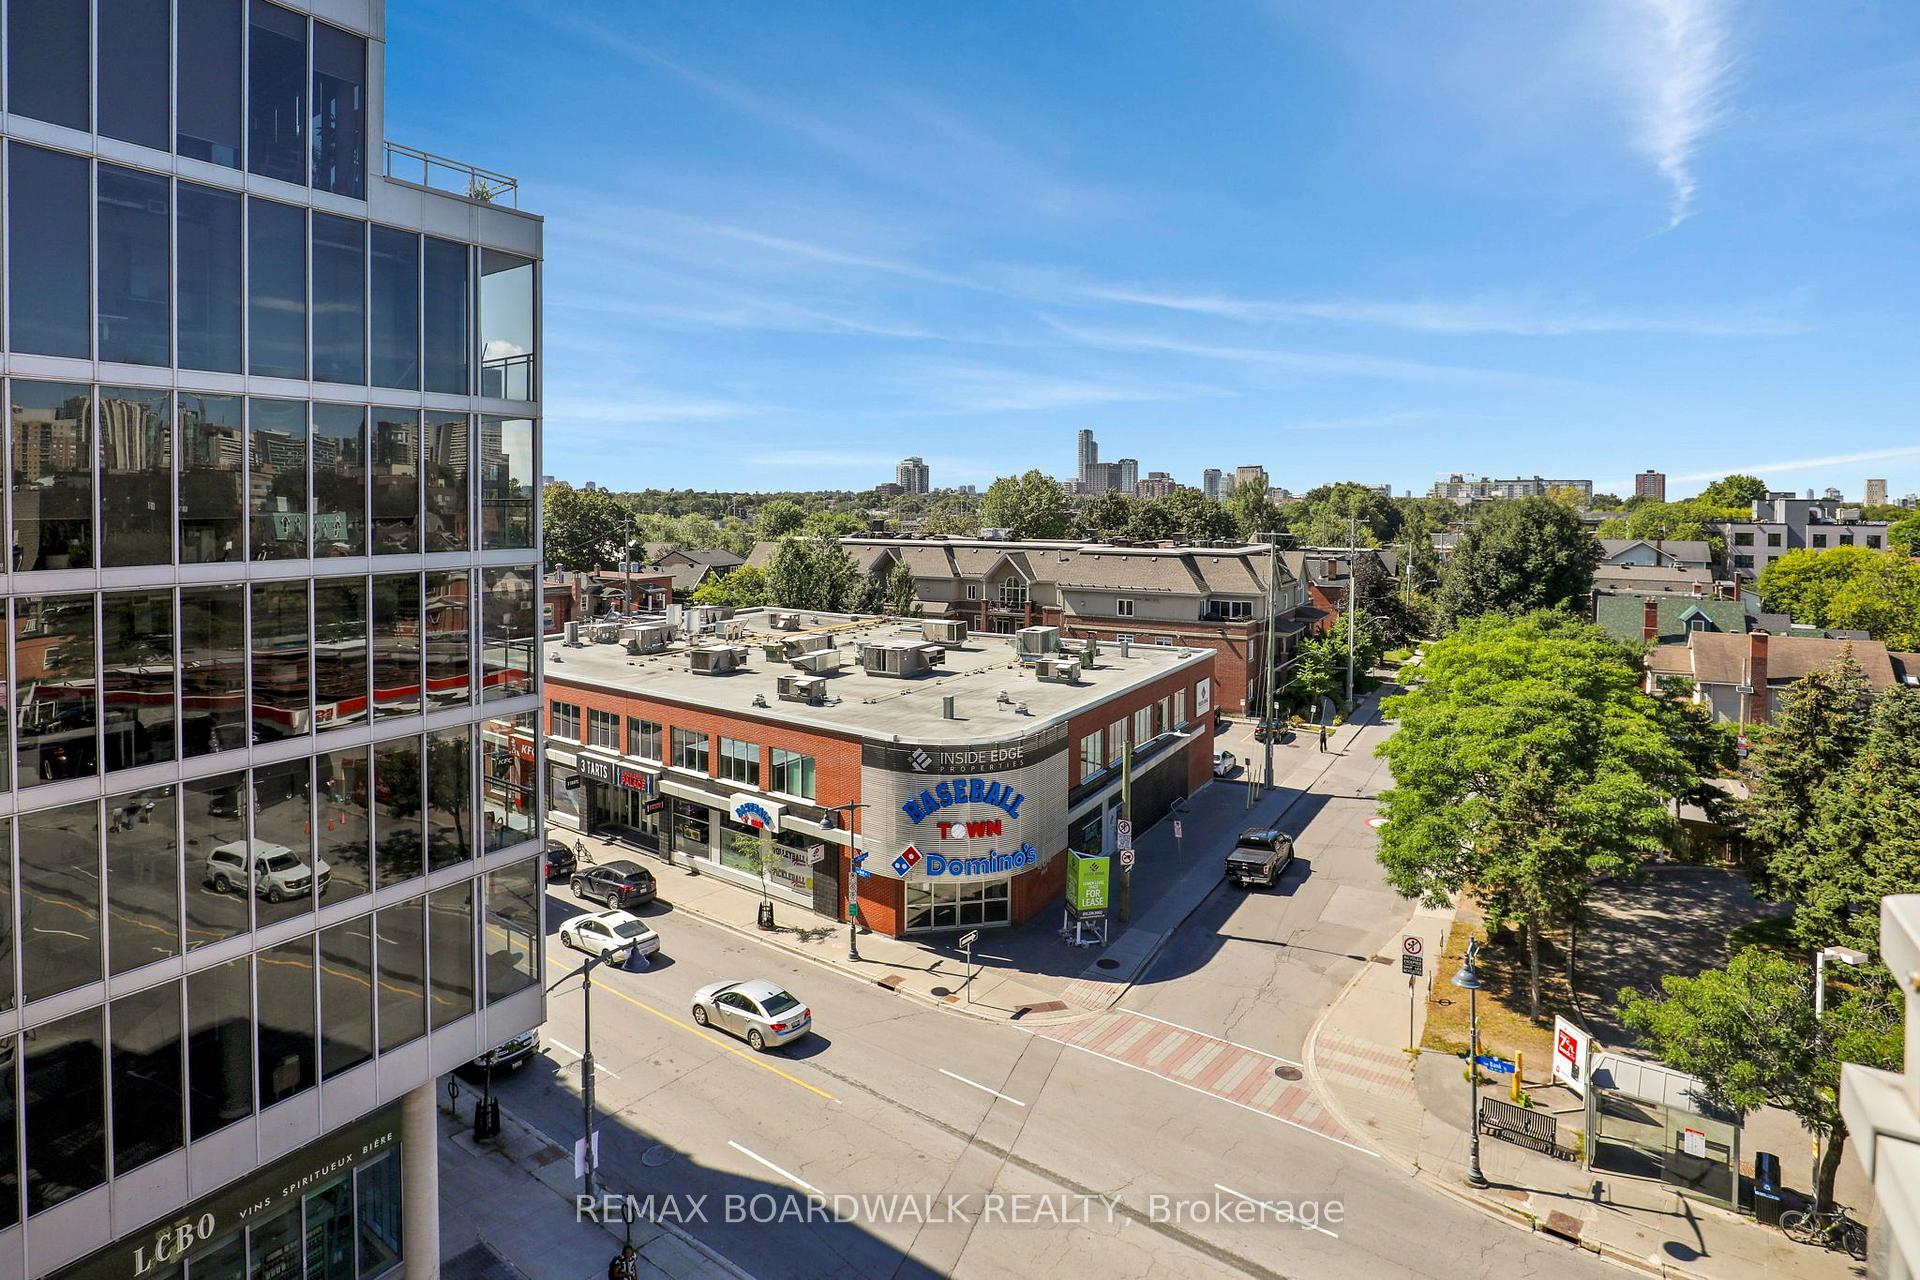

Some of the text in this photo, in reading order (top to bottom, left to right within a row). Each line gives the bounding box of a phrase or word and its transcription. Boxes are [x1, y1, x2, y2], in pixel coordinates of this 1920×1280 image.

[498, 757, 513, 765] KFC
[940, 746, 1024, 765] INSIDE EDGE
[580, 759, 586, 773] 3
[587, 761, 608, 779] TARTS
[940, 761, 1024, 773] PROPERTIES
[902, 778, 1025, 825] BASEBALL
[926, 842, 1038, 877] Domino's
[1082, 897, 1104, 907] LEASE
[1085, 889, 1101, 898] FOR
[133, 1132, 393, 1277] LCBO VINS SPIRITUEUX BIÈRE
